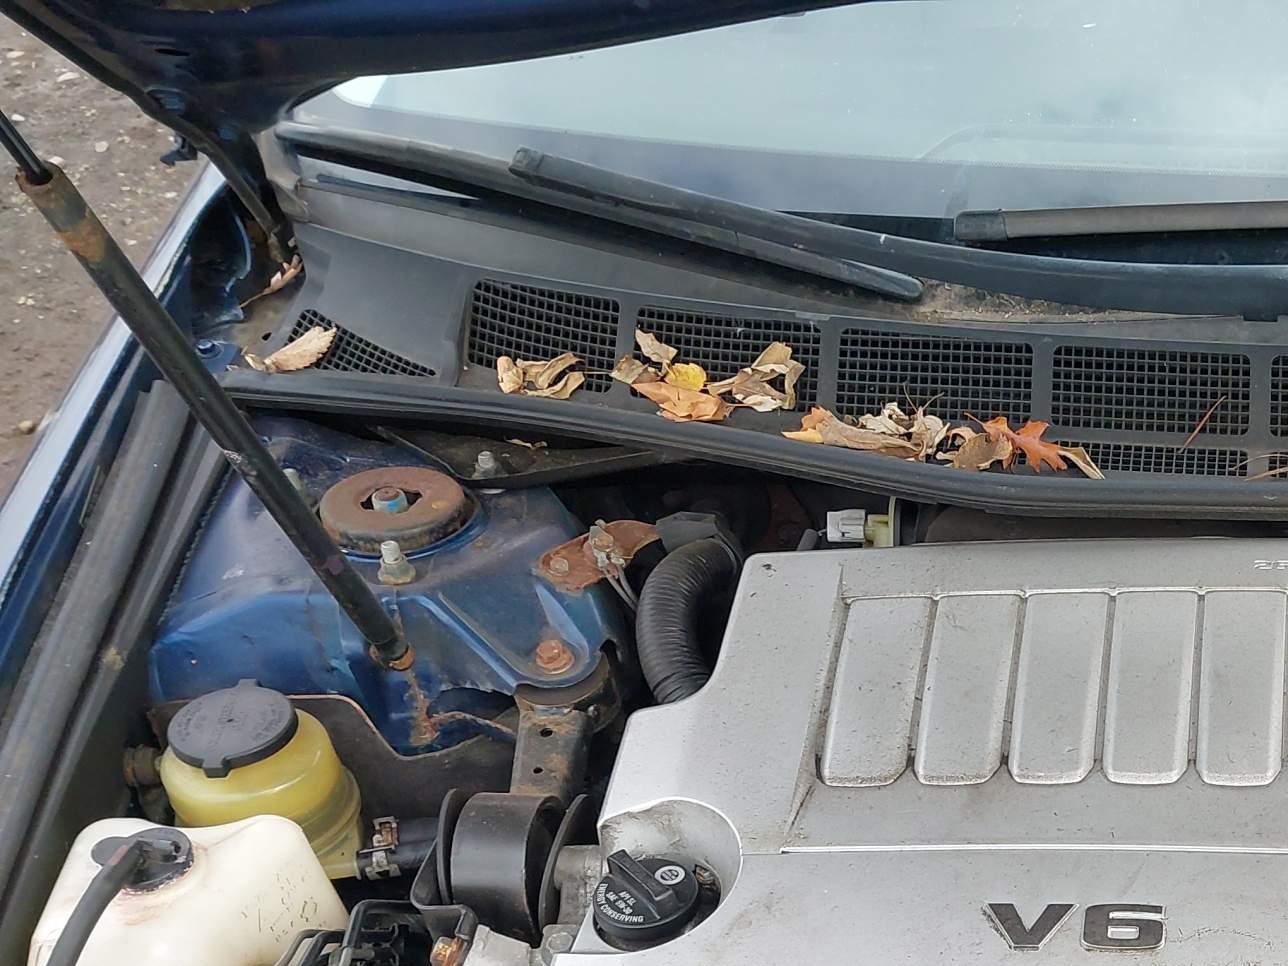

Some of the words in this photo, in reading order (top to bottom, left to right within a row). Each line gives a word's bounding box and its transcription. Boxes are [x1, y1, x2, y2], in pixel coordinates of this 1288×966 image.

[597, 883, 608, 904] ENERGY
[606, 891, 619, 902] SAE
[618, 891, 631, 900] API
[600, 904, 645, 923] CONSERVING
[982, 902, 1167, 951] V6
